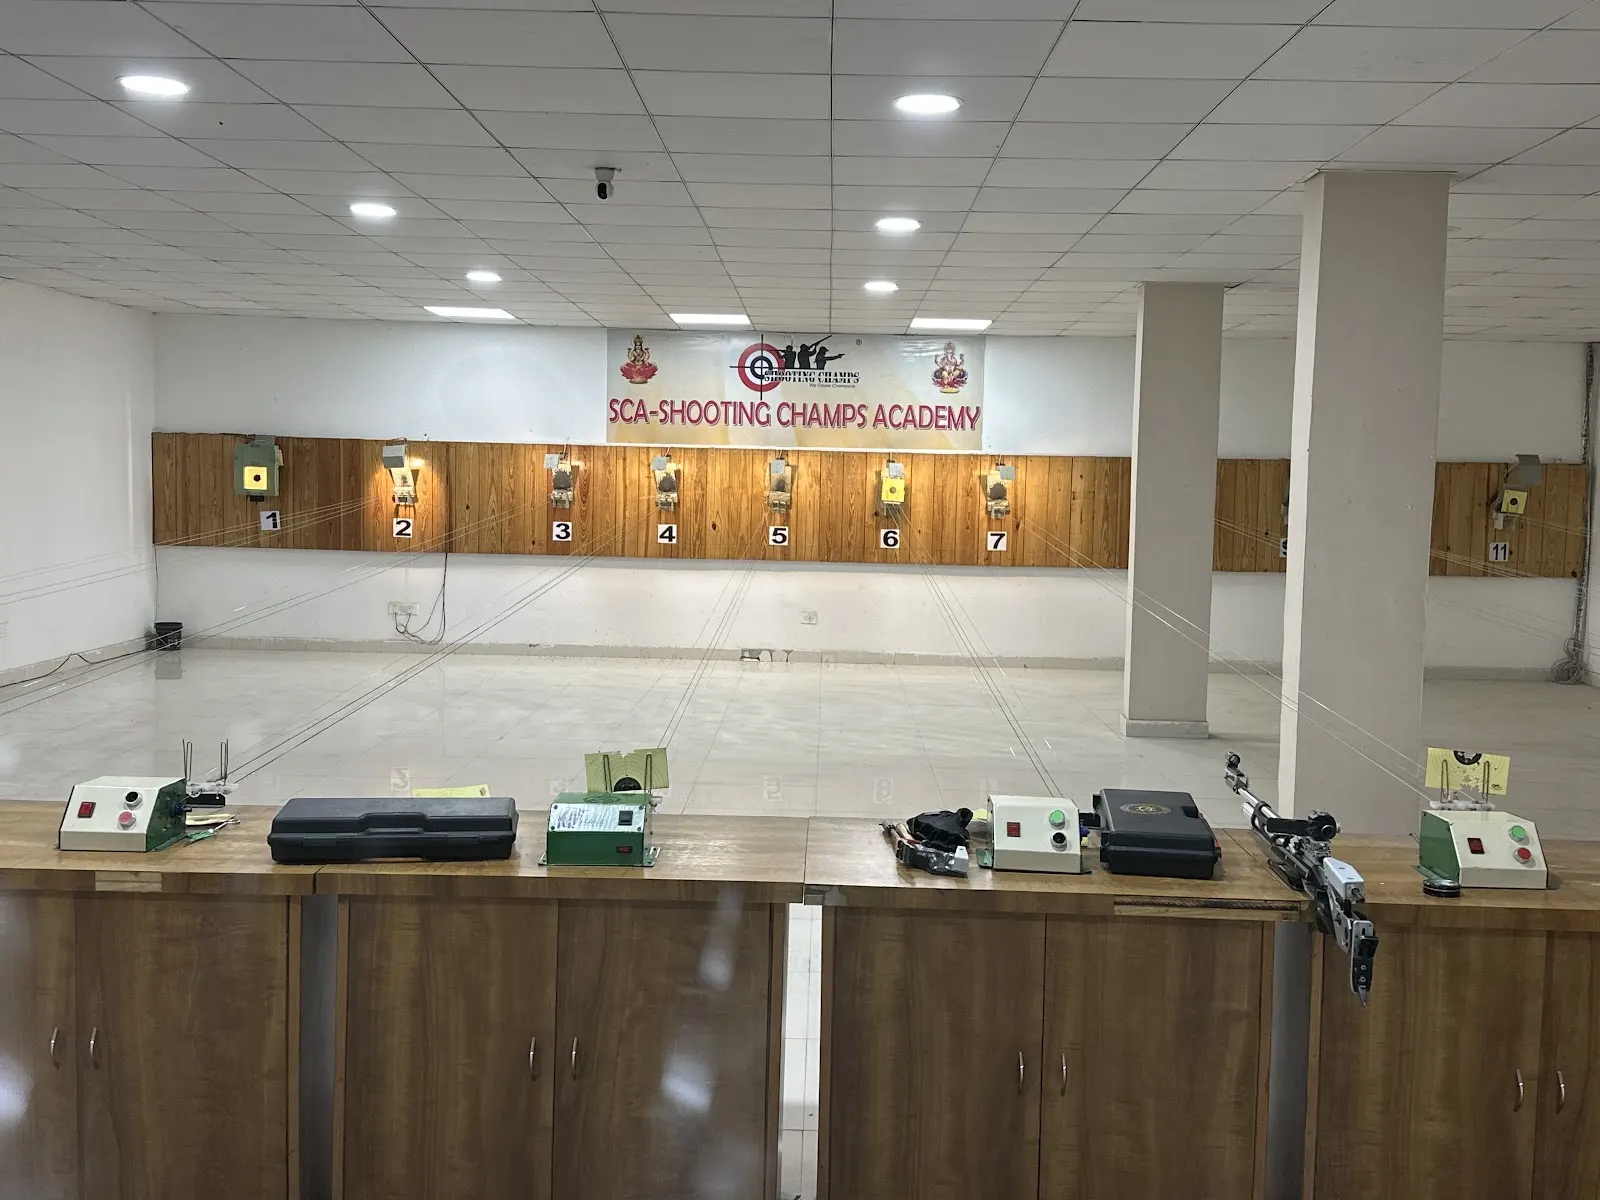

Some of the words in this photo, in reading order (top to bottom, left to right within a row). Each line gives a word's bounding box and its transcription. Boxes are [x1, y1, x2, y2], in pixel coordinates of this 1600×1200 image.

[764, 370, 816, 382] SHOOTING
[817, 372, 860, 383] CHAMPS
[609, 398, 772, 428] SCA-SHOOTING
[776, 401, 868, 430] CHAMPS
[872, 403, 982, 432] ACADEMY
[265, 511, 278, 529] 1
[395, 519, 411, 537] 2
[555, 523, 571, 540] 3
[659, 526, 676, 543] 4
[772, 527, 787, 544] 5
[882, 531, 899, 548] 6
[990, 534, 1006, 550] 7
[1492, 543, 1508, 561] 11
